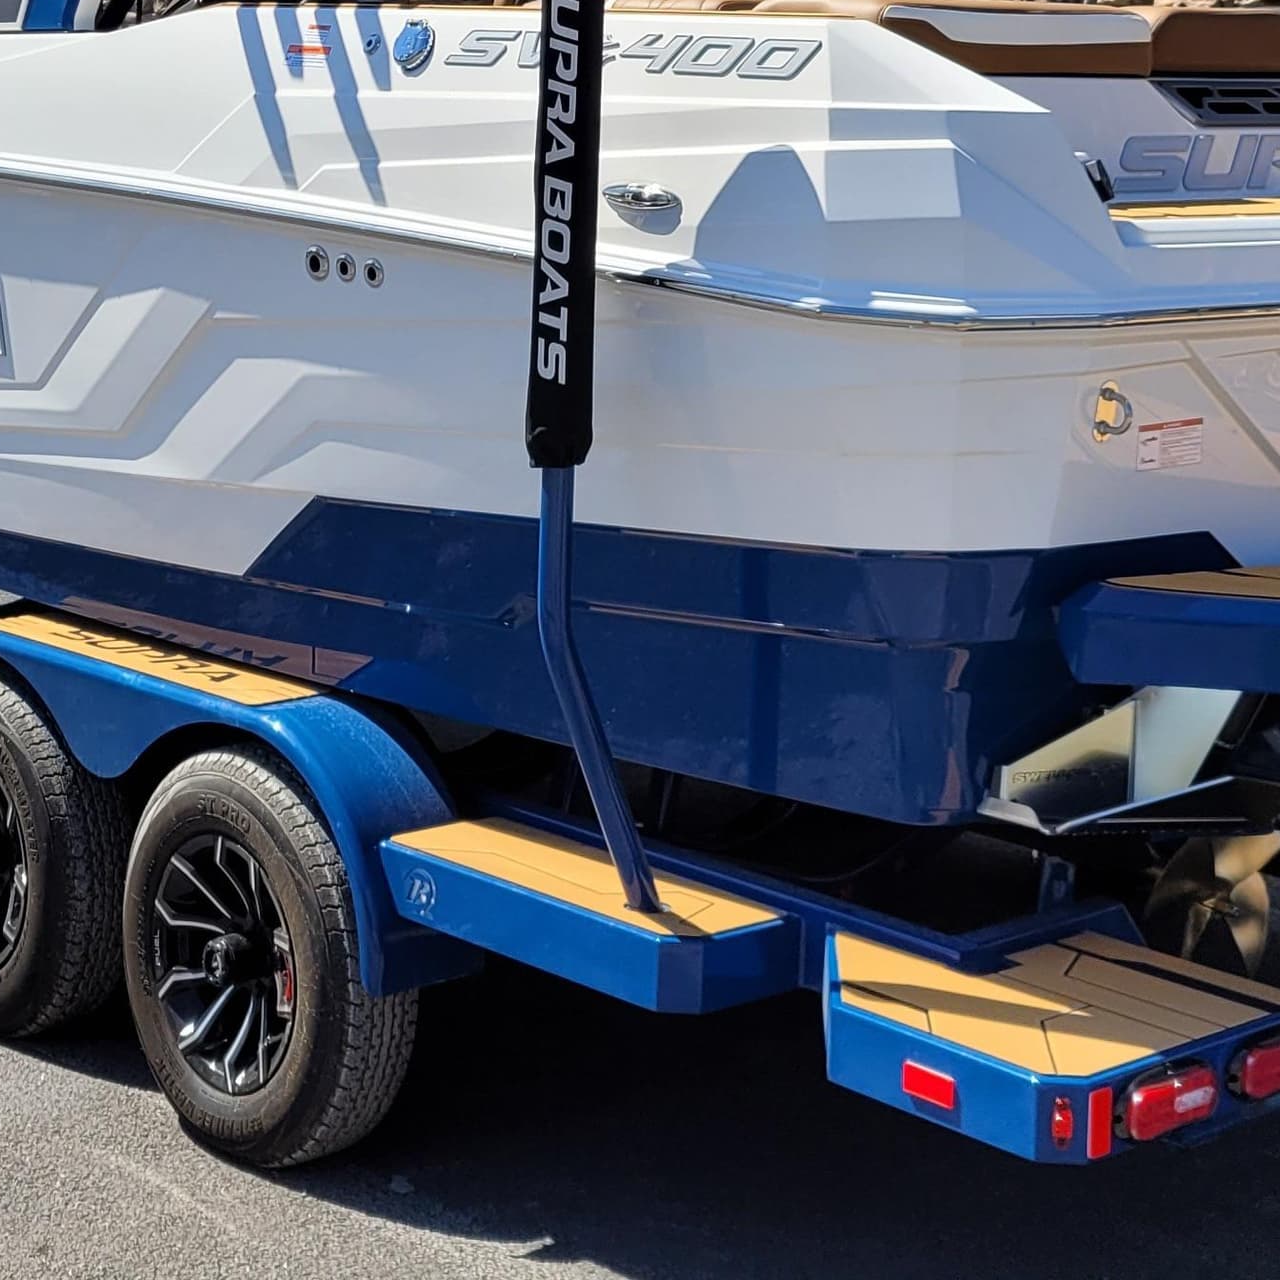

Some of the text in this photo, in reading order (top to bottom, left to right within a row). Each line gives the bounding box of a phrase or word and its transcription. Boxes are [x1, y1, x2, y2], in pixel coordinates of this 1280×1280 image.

[536, 175, 573, 386] BOATS
[49, 627, 241, 684] SUPRA
[152, 928, 161, 967] FUEL
